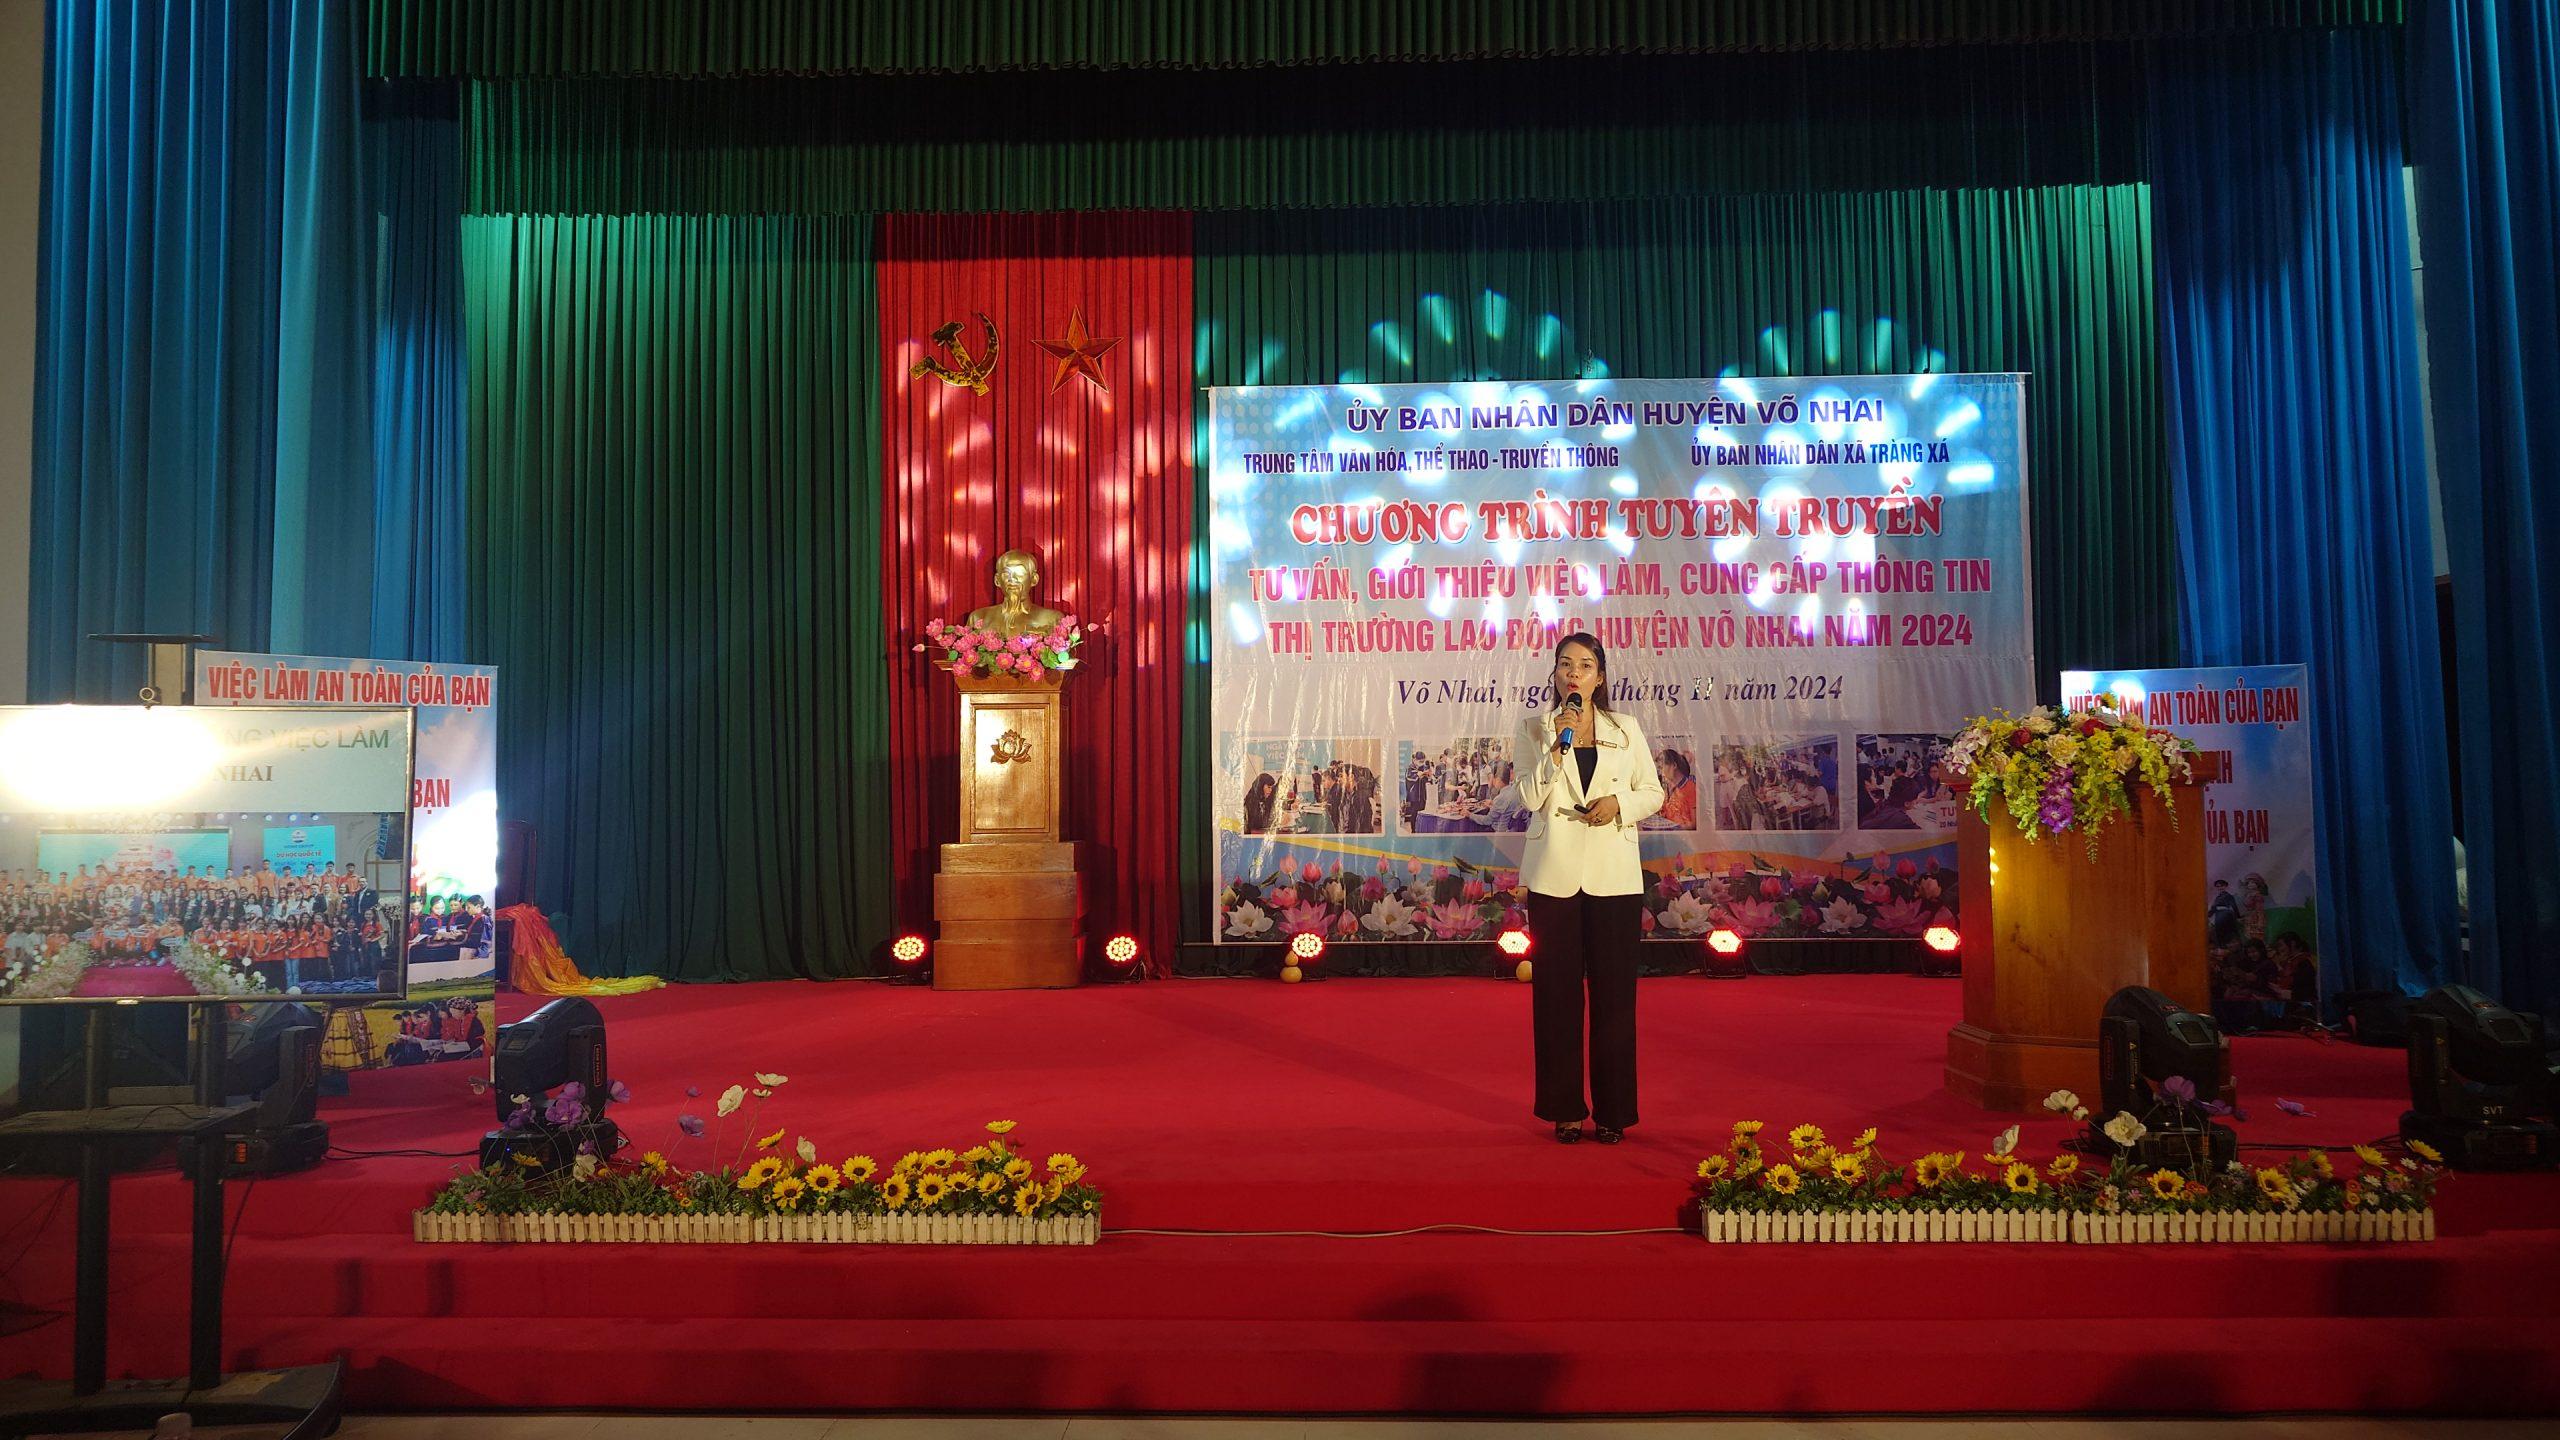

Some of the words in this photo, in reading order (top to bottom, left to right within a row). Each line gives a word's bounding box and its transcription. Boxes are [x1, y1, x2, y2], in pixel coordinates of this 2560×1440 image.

[1348, 399, 1389, 431] ỦY
[1400, 407, 1461, 430] BAN
[1472, 400, 1558, 428] NHÂN
[1568, 398, 1633, 427] DÂN
[1644, 397, 1746, 431] HUYỆN
[1756, 396, 1799, 425] VÕ
[1809, 400, 1883, 424] NHAI
[1244, 453, 1295, 473] TRUNG
[1300, 448, 1334, 472] TÂM
[1339, 447, 1371, 472] VĂN
[1375, 445, 1412, 474] HÓA,
[1415, 442, 1443, 471] THỂ
[1448, 448, 1488, 470] THAO
[1501, 440, 1561, 470] TRUYỀN
[1567, 442, 1619, 467] THÔNG
[1691, 438, 1714, 466] ỦY
[1717, 445, 1750, 466] BAN
[1755, 439, 1800, 465] NHÂN
[1805, 439, 1838, 464] DÂN
[1843, 438, 1866, 464] XÃ
[1870, 438, 1923, 464] TRÀNG
[1927, 438, 1950, 463] XÁ
[1292, 499, 1468, 543] CHƯƠNG
[1479, 490, 1609, 540] TRÌNH
[1619, 486, 1759, 537] TUYÊN
[1772, 476, 1943, 536] TRUYỀN
[1249, 567, 1287, 601] TƯ
[1292, 557, 1358, 605] VẤN,
[1367, 559, 1425, 600] GIỚI
[1434, 560, 1515, 604] THIỆU
[1525, 559, 1588, 603] VIỆC
[1601, 555, 1670, 599] LÀM,
[1680, 562, 1758, 595] CUNG
[1770, 551, 1826, 594] CẤP
[1837, 554, 1934, 594] THÔNG
[1943, 560, 1991, 592] TIN
[1268, 621, 1313, 661] THỊ
[1321, 611, 1435, 654] TRƯỜNG
[1444, 620, 1496, 652] LAO
[1595, 610, 1689, 656] HUYỆN
[1699, 610, 1735, 648] VÕ
[1745, 615, 1814, 648] NHAI
[1825, 607, 1892, 647] NĂM
[1902, 614, 1973, 646] 2024
[208, 661, 256, 706] VIỆC
[263, 662, 309, 700] LÀM
[315, 671, 345, 702] AN
[350, 666, 402, 704] TOÀN
[407, 664, 446, 705] CỦA
[451, 676, 490, 712] BẠN
[1397, 680, 1430, 704] Võ
[1437, 680, 1502, 708] Nhai,
[1612, 677, 1680, 707] tháng
[1725, 678, 1777, 700] năm
[1784, 676, 1844, 701] 2024
[2149, 692, 2172, 725] AN
[2176, 683, 2220, 725] TOÀN
[2225, 677, 2259, 723] CỦA
[2263, 687, 2299, 730] BẠN
[338, 725, 389, 748] LÀM
[414, 779, 450, 814] BẠN
[2206, 799, 2230, 844] ỦA
[2234, 810, 2269, 852] BẠN
